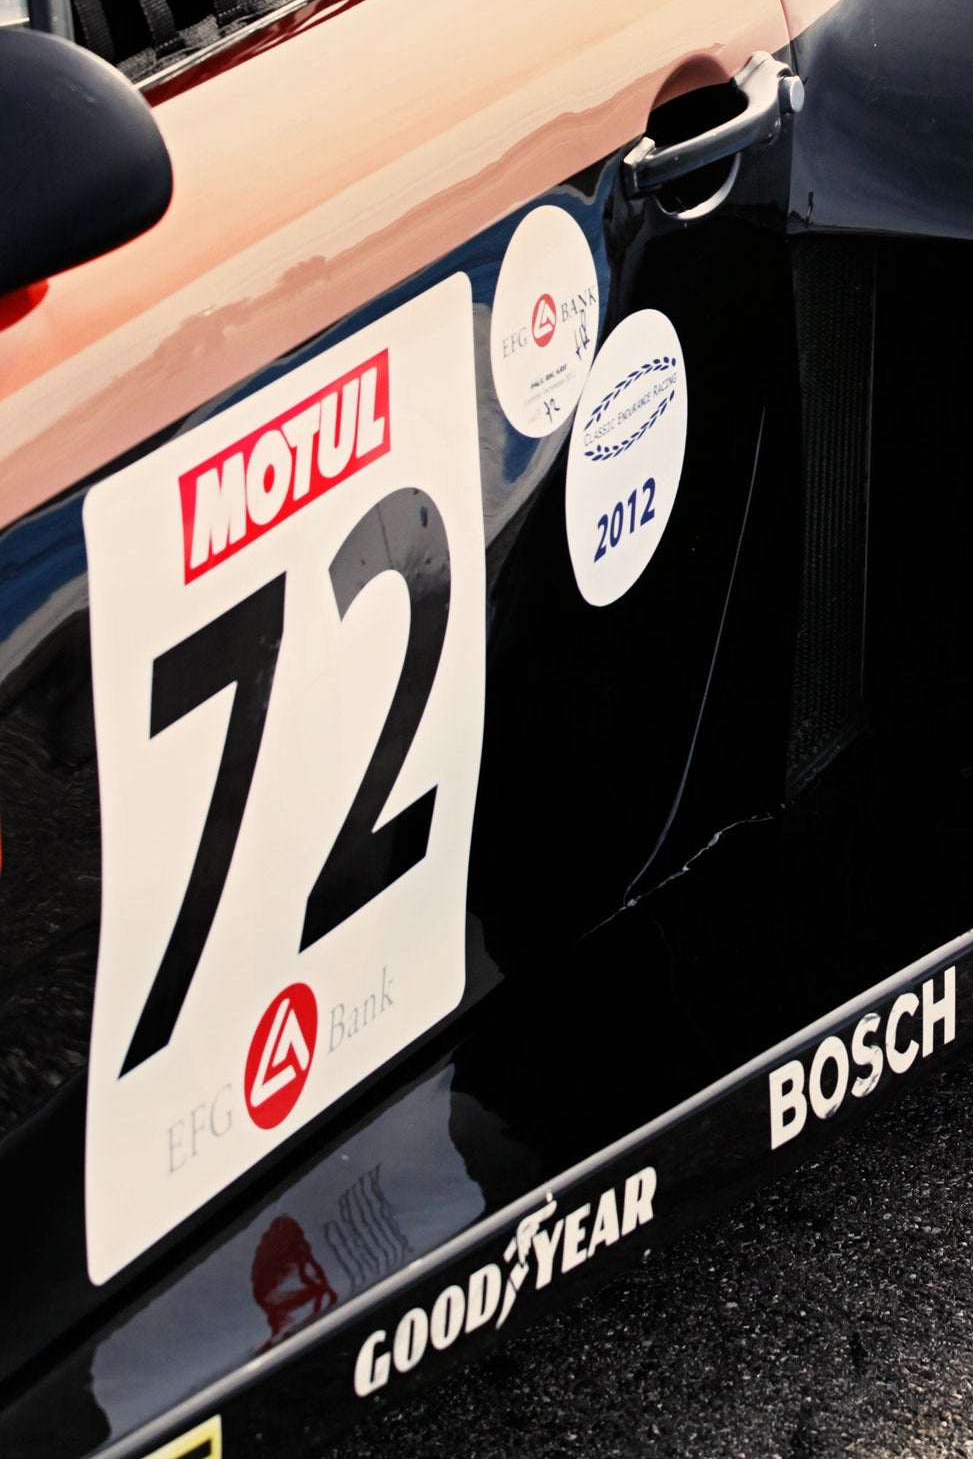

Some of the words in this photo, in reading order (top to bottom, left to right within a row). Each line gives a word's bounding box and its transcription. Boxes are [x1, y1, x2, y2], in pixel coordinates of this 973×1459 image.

[501, 326, 529, 360] EFG
[560, 284, 598, 324] BANK
[583, 419, 616, 447] CLASSIC
[617, 393, 652, 427] ENDURANCE
[652, 372, 678, 399] RACING
[189, 366, 386, 571] MOTUL
[593, 476, 657, 564] 2012
[117, 486, 452, 1081] 72
[165, 1083, 235, 1176] EFG
[326, 965, 395, 1055] Bank
[768, 965, 956, 1151] BOSCH
[354, 1165, 657, 1398] GOODYEAR
